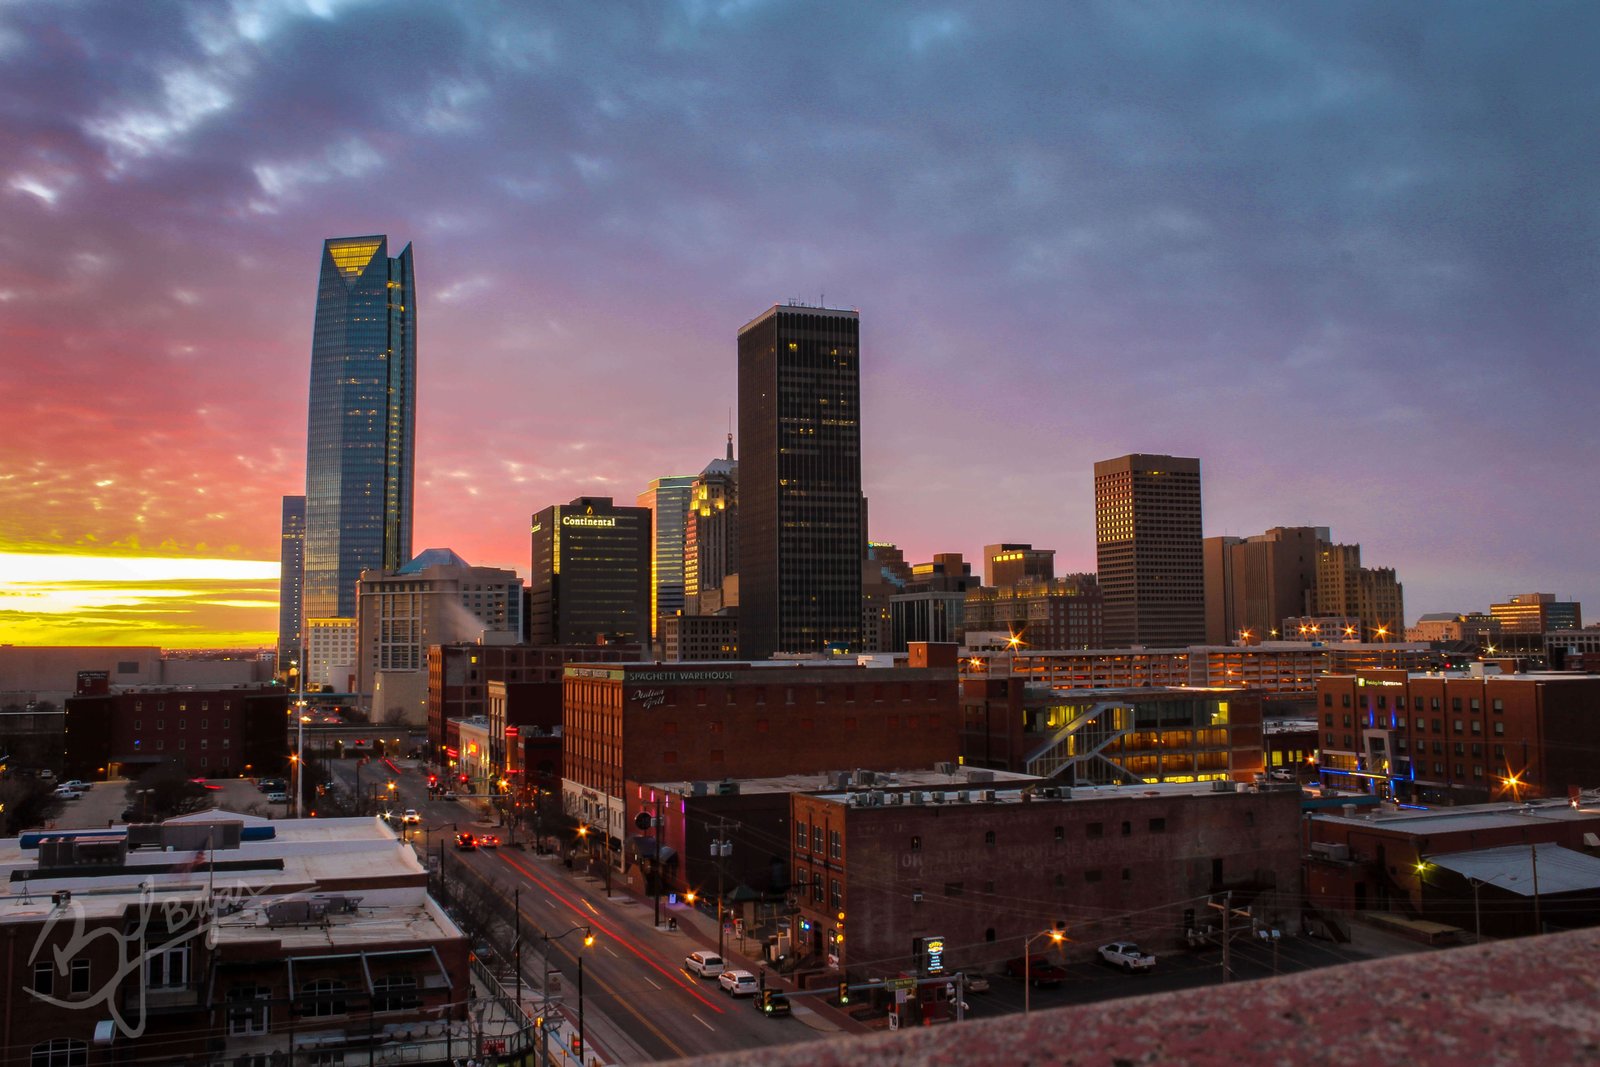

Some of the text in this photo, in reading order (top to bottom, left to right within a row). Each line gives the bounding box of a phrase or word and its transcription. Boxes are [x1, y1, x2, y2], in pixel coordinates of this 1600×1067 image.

[562, 516, 616, 527] Continental
[629, 671, 734, 681] SPAGHETTI WAREHOUSE
[631, 689, 665, 701] Italian
[642, 696, 665, 709] Grill
